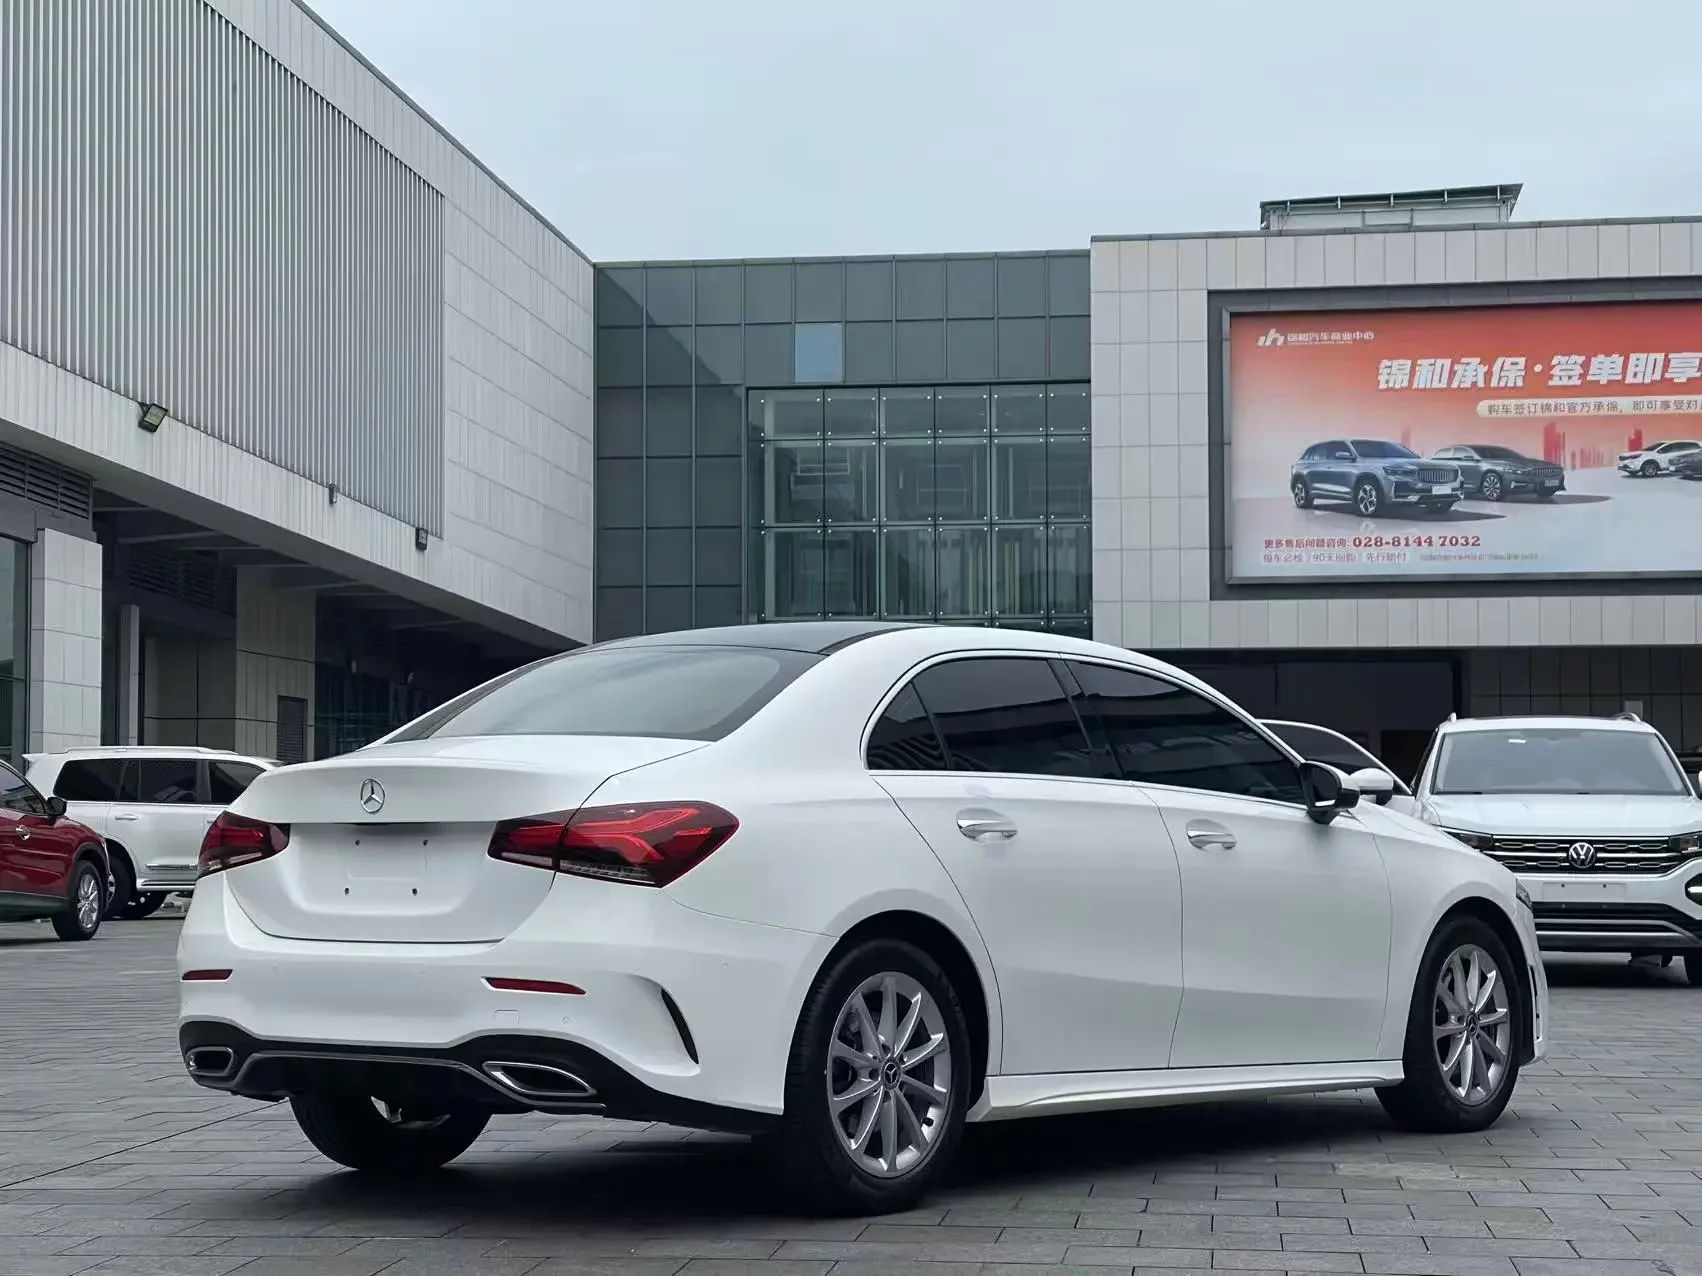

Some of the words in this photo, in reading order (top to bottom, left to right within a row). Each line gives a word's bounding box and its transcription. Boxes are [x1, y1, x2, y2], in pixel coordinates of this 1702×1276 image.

[1487, 399, 1702, 416] 购车签订锦和官方承保，即可享受对
[1352, 535, 1434, 548] 028-8144
[1438, 535, 1481, 547] 7032
